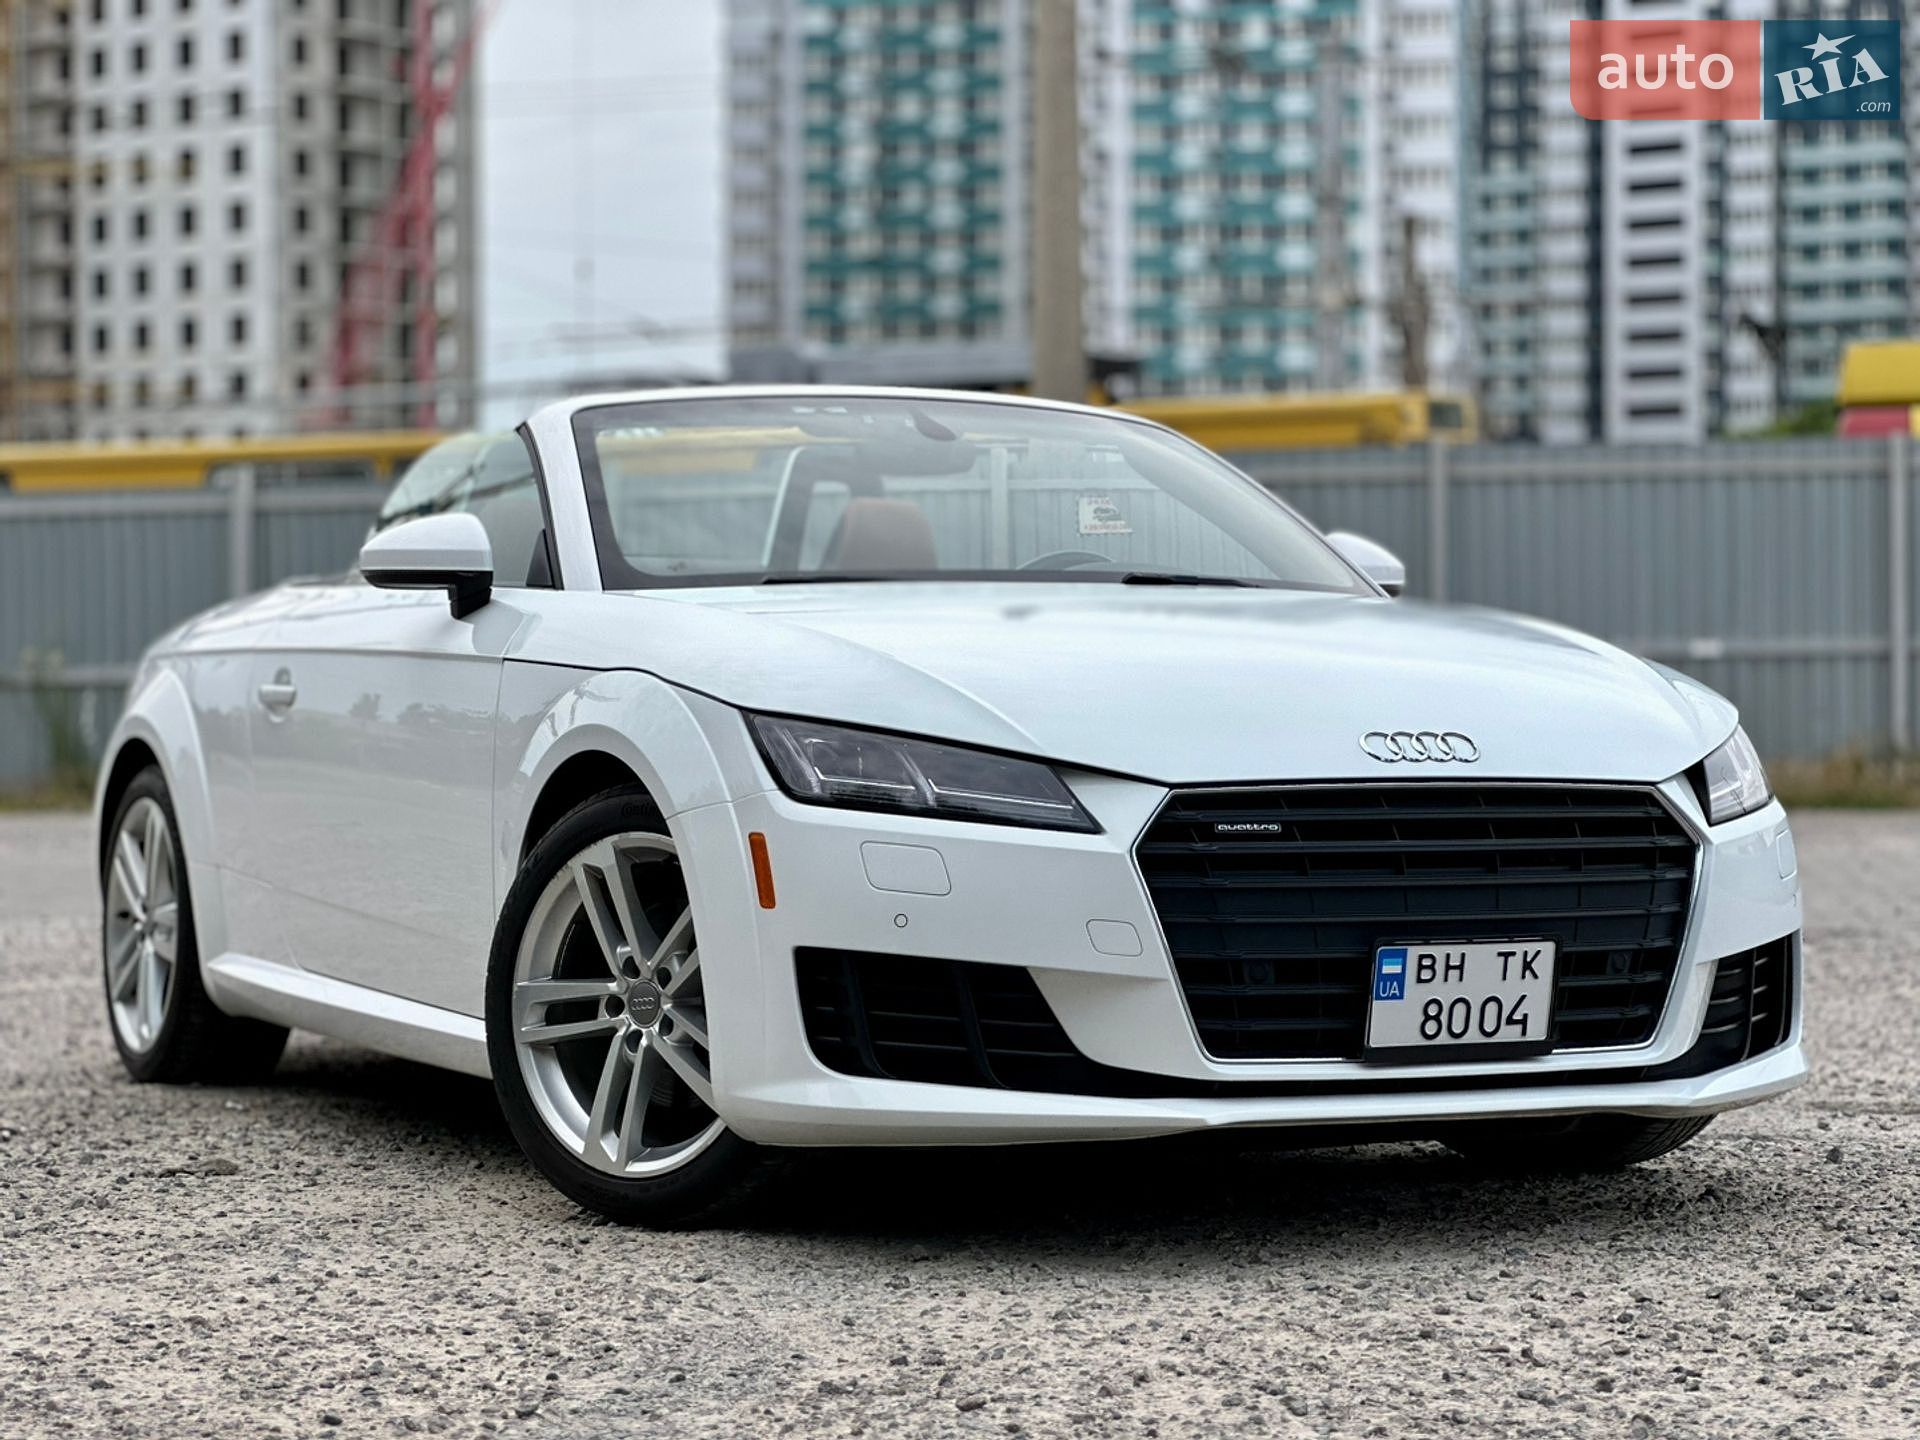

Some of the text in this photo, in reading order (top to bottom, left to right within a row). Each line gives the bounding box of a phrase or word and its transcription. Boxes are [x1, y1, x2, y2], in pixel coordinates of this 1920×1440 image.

[1218, 823, 1278, 831] quattro
[1416, 949, 1542, 984] BH TK
[1379, 981, 1400, 997] UA
[1420, 994, 1529, 1040] 8004
